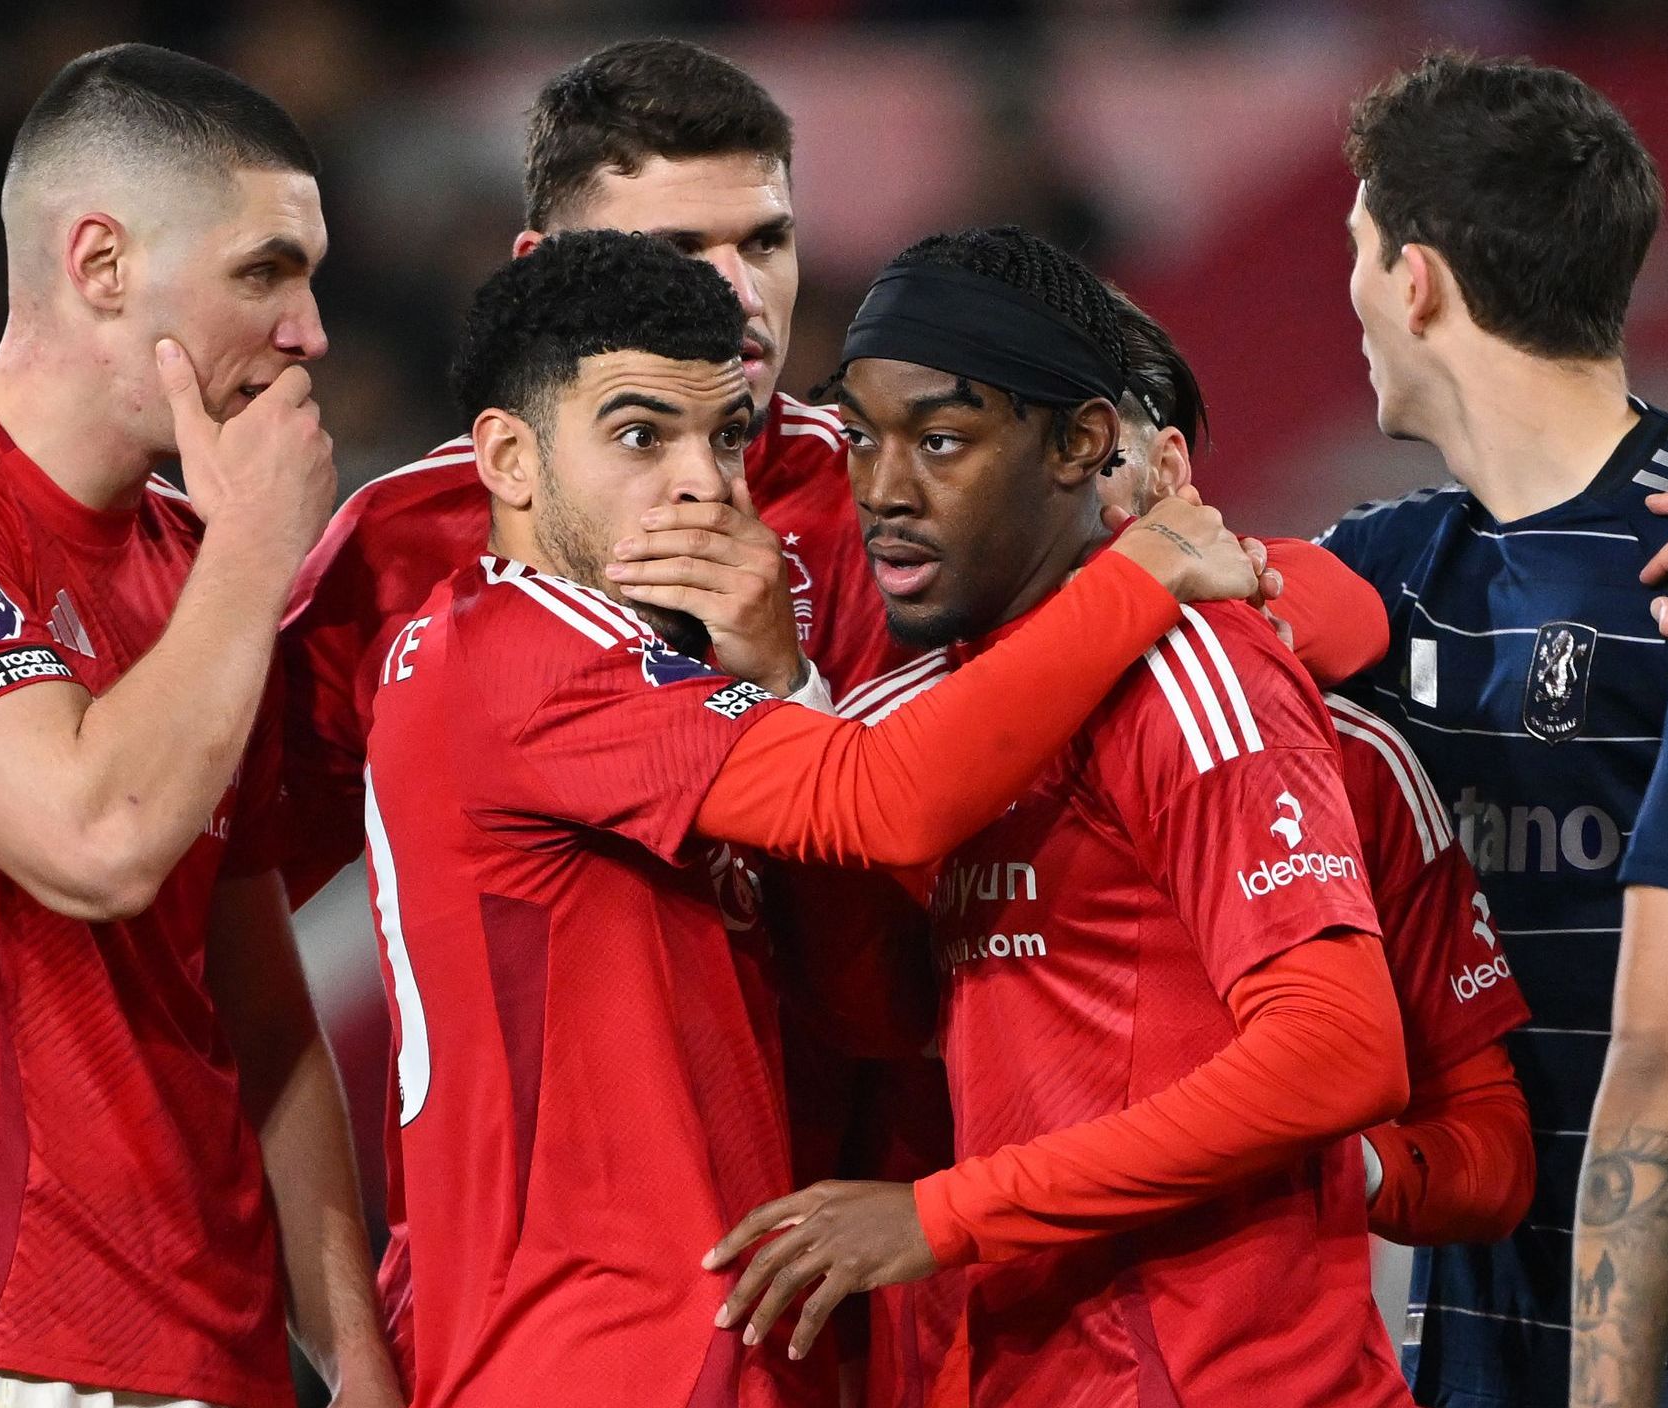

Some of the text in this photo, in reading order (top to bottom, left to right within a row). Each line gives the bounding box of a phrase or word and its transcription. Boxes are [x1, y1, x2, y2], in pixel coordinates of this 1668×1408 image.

[0, 649, 57, 668] room
[7, 663, 73, 682] racism
[703, 689, 740, 712] No
[1237, 852, 1358, 901] Ideagen
